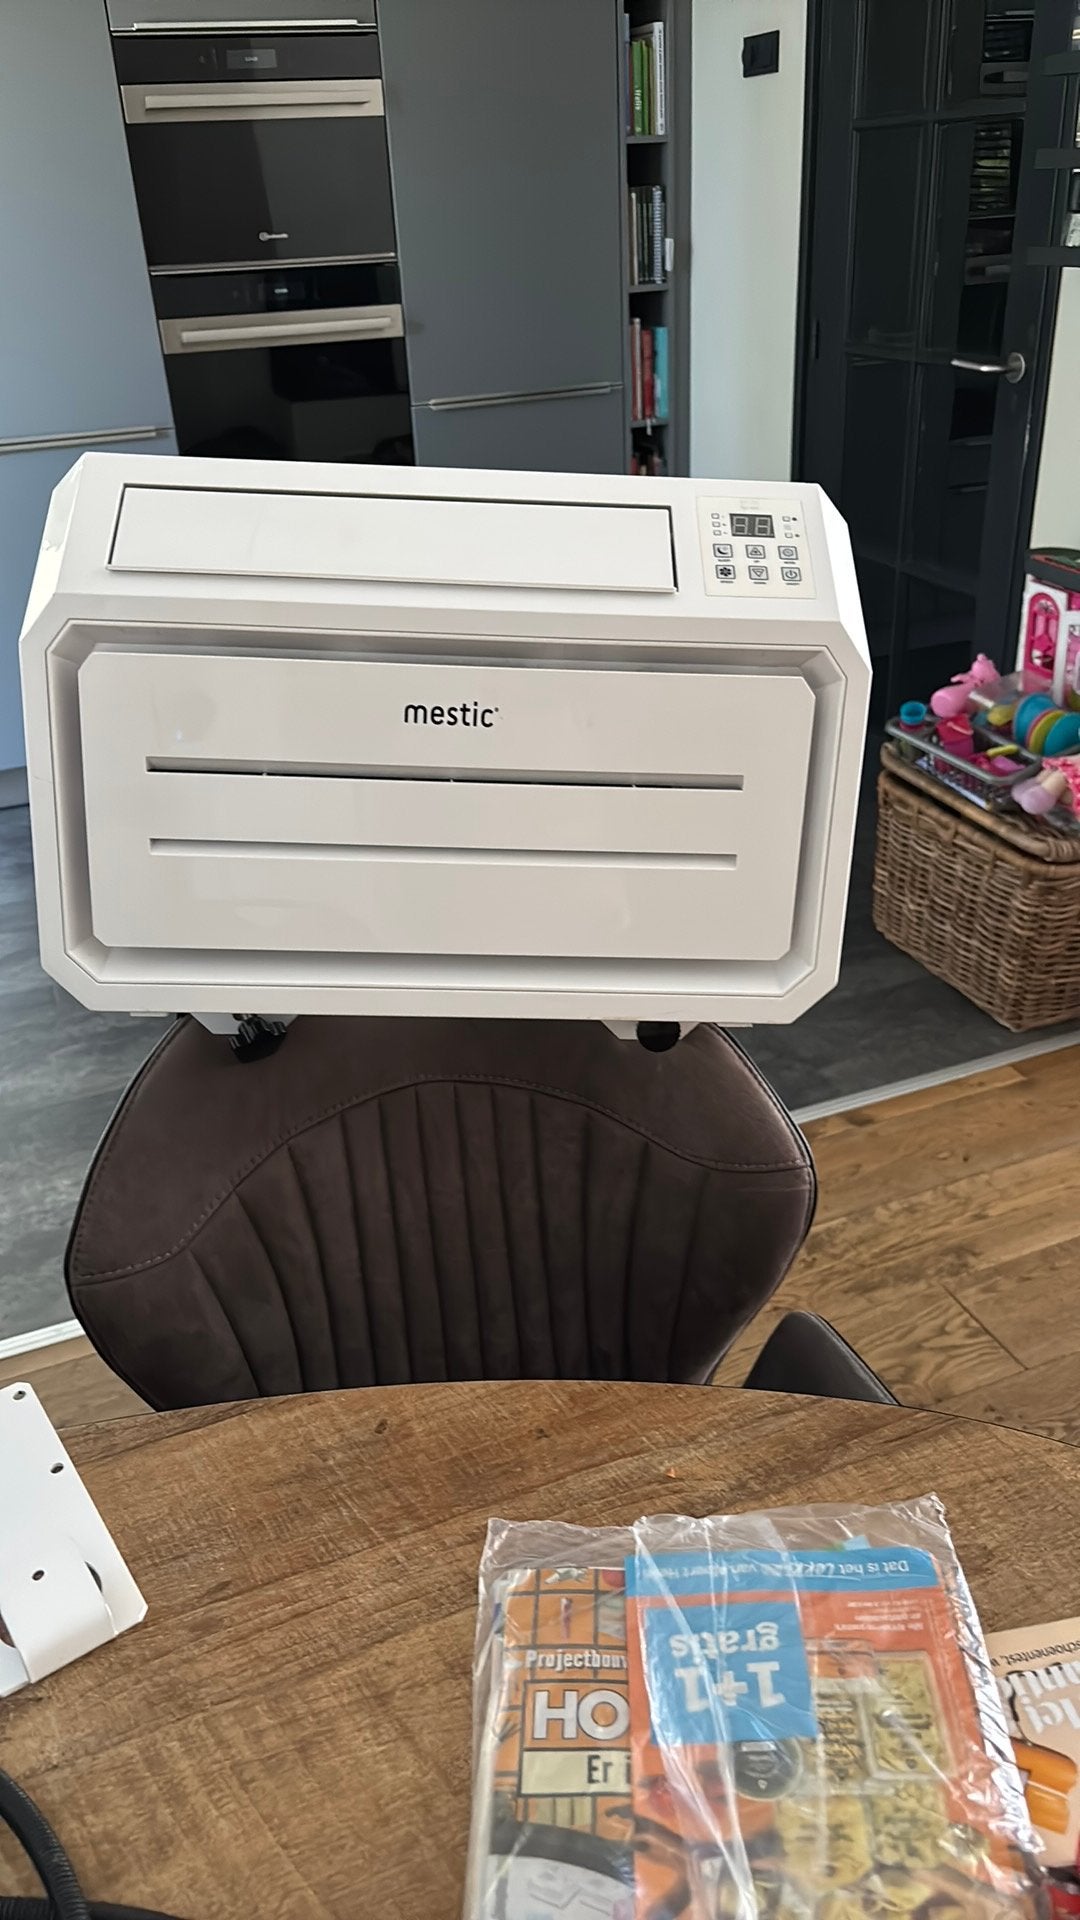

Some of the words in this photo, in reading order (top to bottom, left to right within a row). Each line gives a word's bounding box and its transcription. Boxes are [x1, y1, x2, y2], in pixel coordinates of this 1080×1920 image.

[404, 701, 494, 728] mestic
[840, 1563, 864, 1574] het
[868, 1561, 880, 1572] is
[883, 1560, 909, 1572] Dat
[670, 1622, 779, 1665] gratis
[675, 1661, 785, 1712] 1+1
[533, 1688, 629, 1740] HO
[587, 1754, 613, 1784] Er
